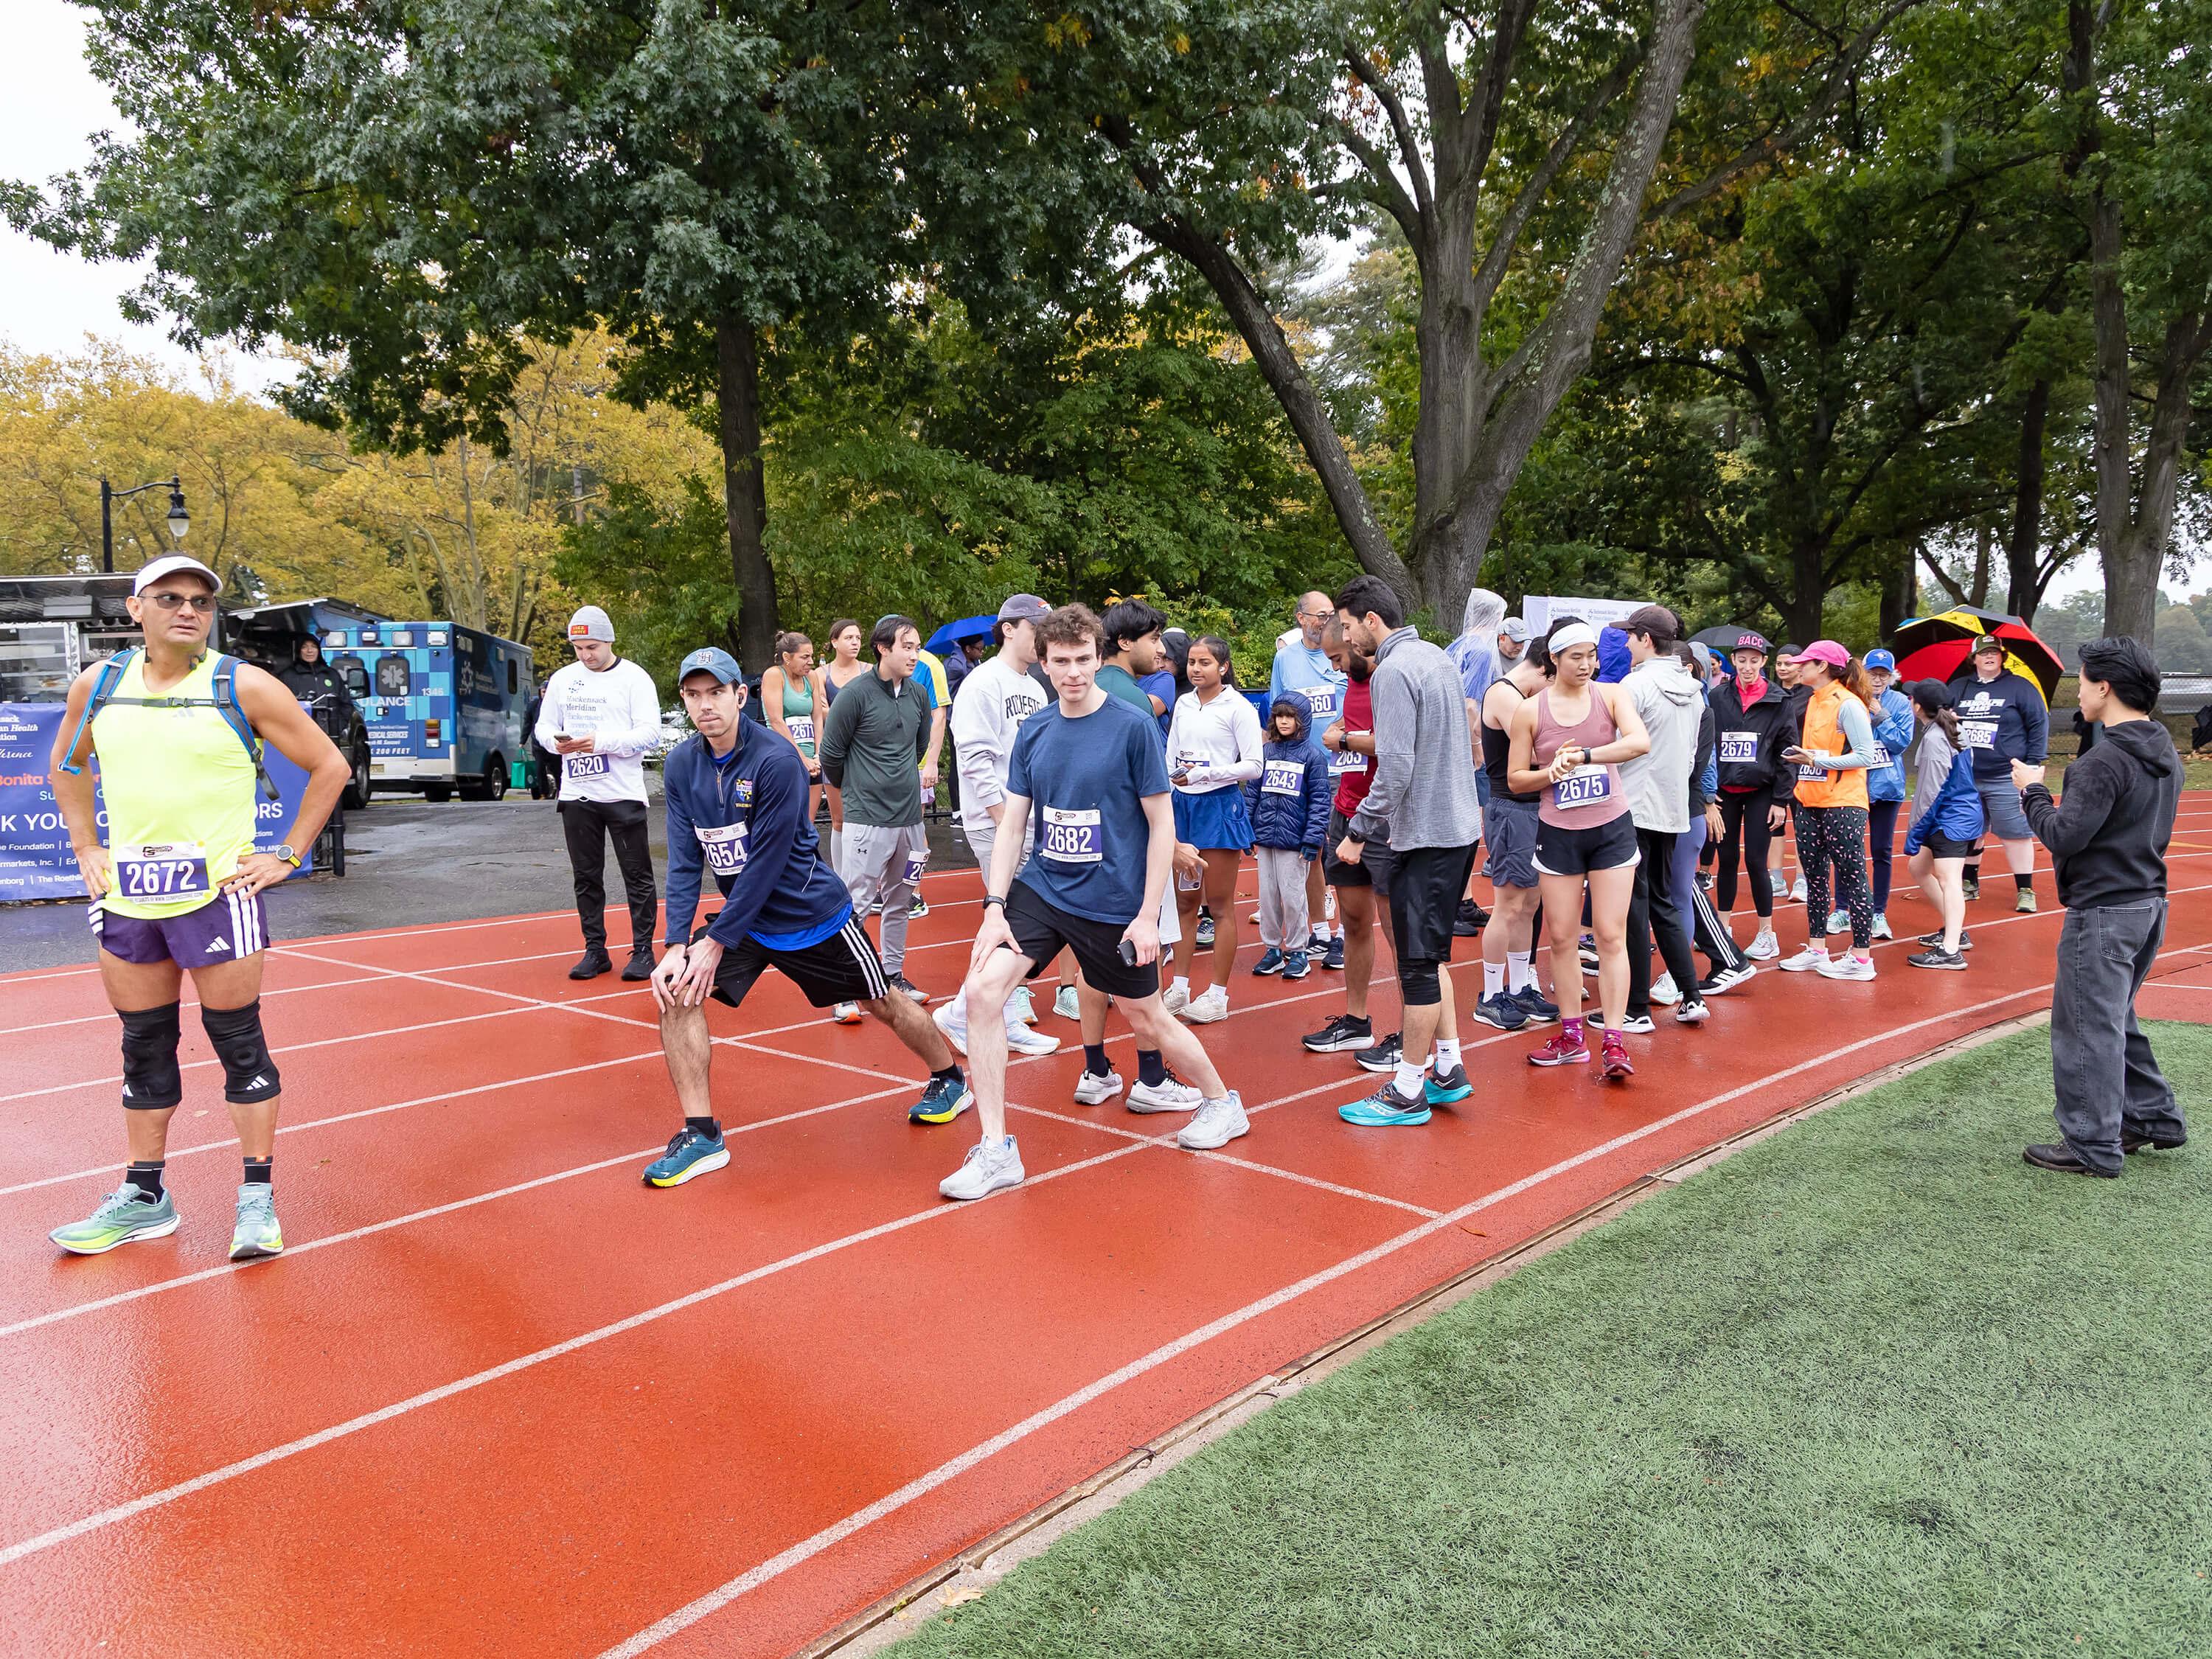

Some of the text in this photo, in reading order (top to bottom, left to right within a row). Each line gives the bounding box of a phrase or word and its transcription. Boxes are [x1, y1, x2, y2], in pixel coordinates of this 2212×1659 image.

[1738, 636, 1763, 647] BACC
[566, 703, 597, 712] Meridian
[1005, 695, 1040, 719] ROCHESTE
[1308, 695, 1332, 713] 660
[11, 724, 38, 732] Health
[1721, 741, 1752, 757] 2679
[1874, 748, 1891, 764] 681
[571, 755, 604, 777] 2620
[1265, 770, 1297, 790] 2643
[1559, 775, 1604, 802] 2675
[9, 843, 55, 851] Foundation
[1047, 824, 1093, 853] 2682
[38, 875, 53, 883] The
[126, 860, 198, 894] 2672
